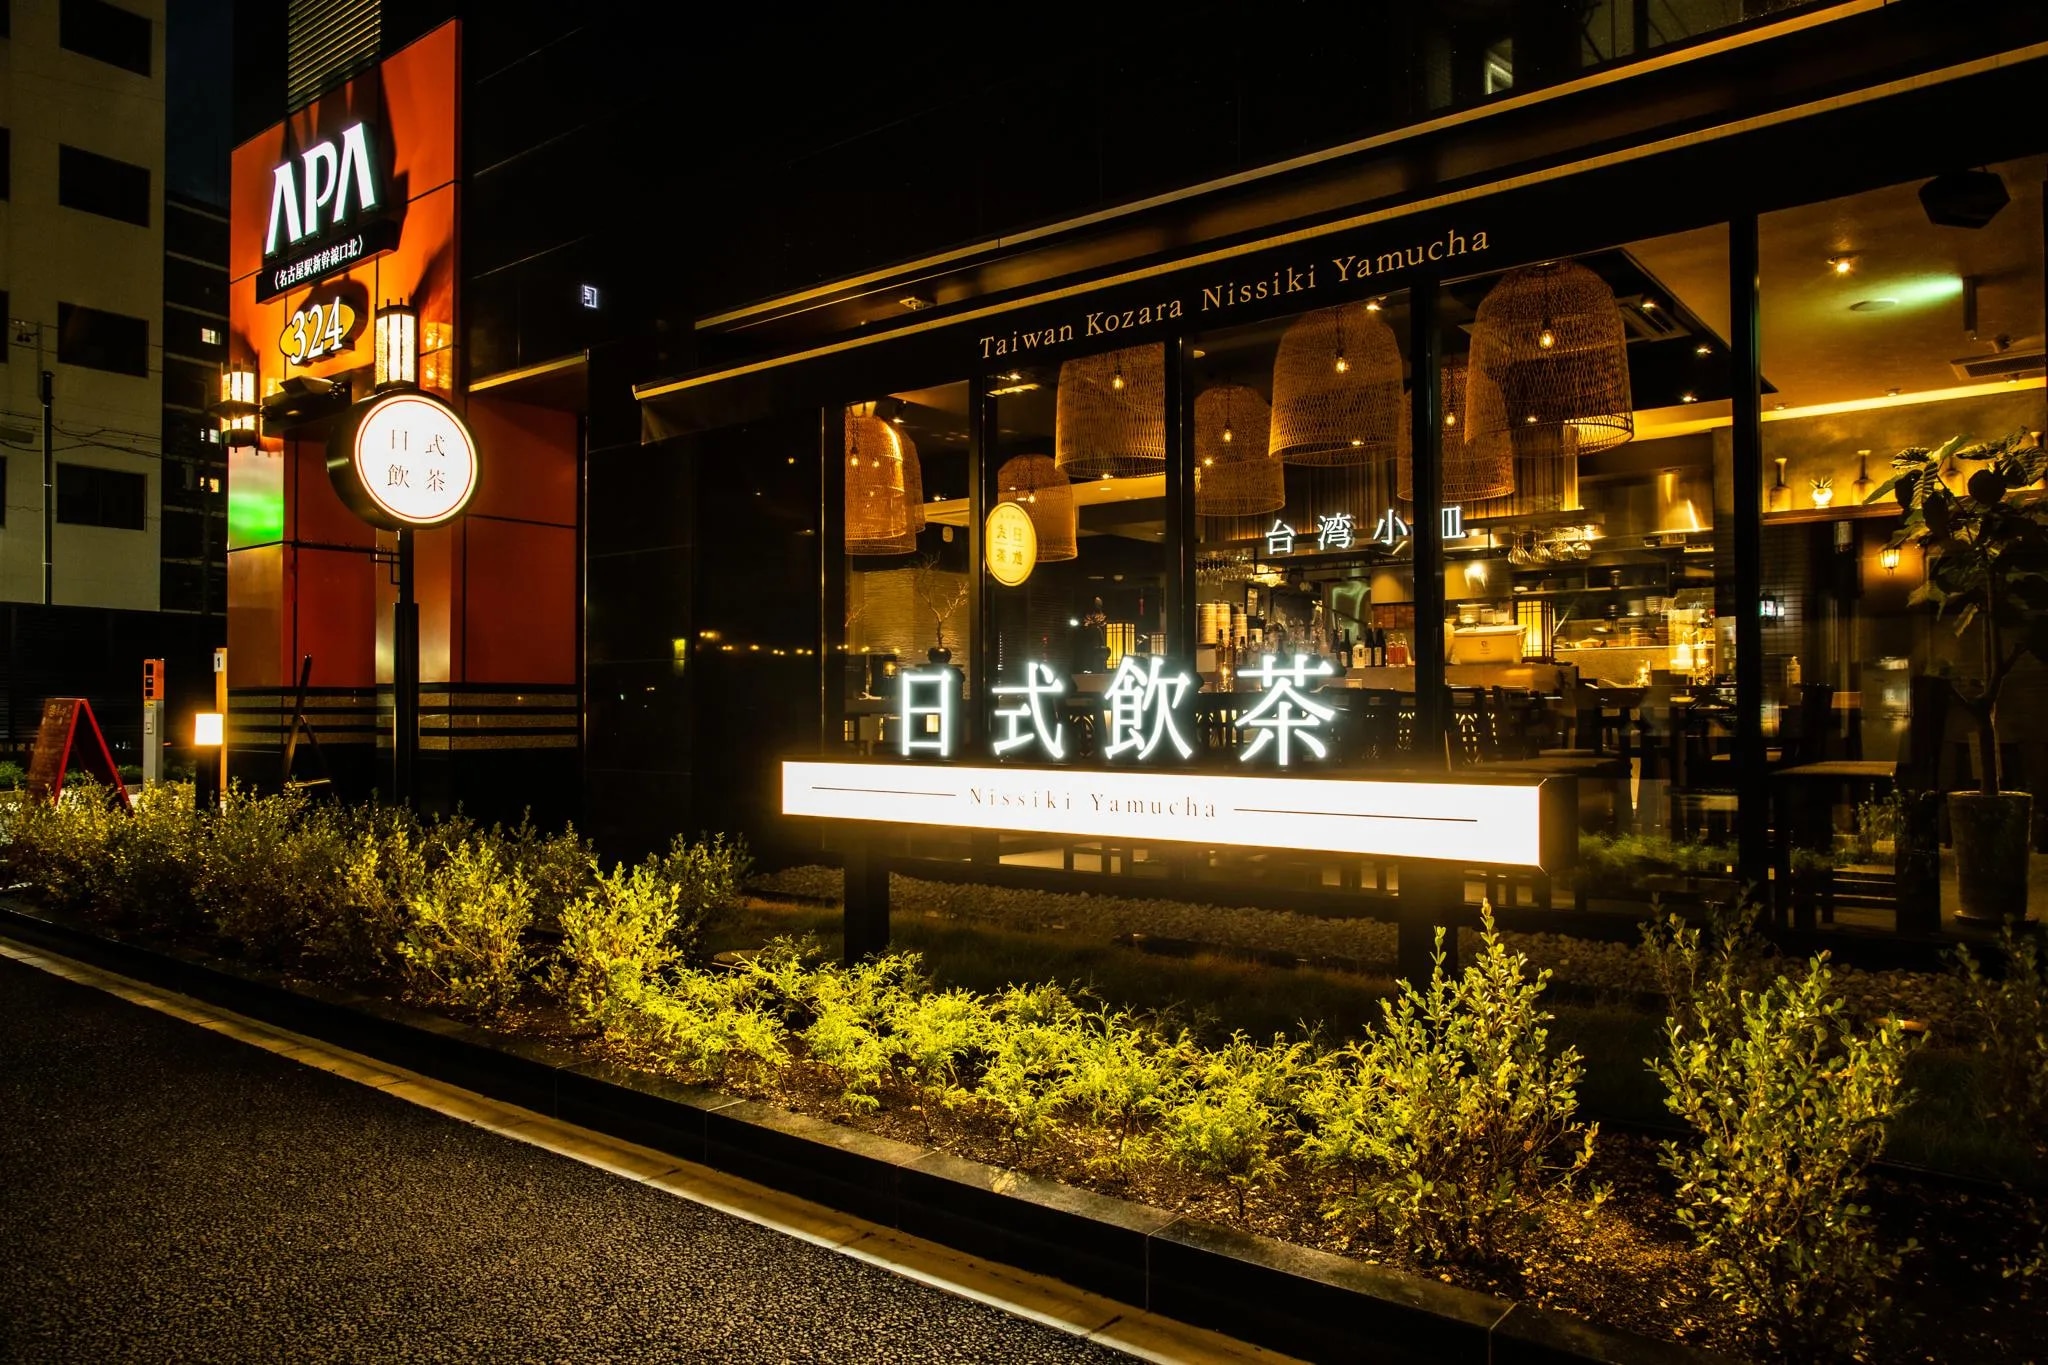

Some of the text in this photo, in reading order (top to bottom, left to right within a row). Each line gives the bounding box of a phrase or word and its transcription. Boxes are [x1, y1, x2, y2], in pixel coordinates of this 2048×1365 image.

[265, 122, 376, 255] APA
[289, 296, 344, 365] 324
[980, 228, 1490, 359] Taiwan Kozara Nissiki Yamucha
[898, 654, 1337, 766] 日式飲茶
[970, 787, 1216, 818] Nissiki Yamucha
